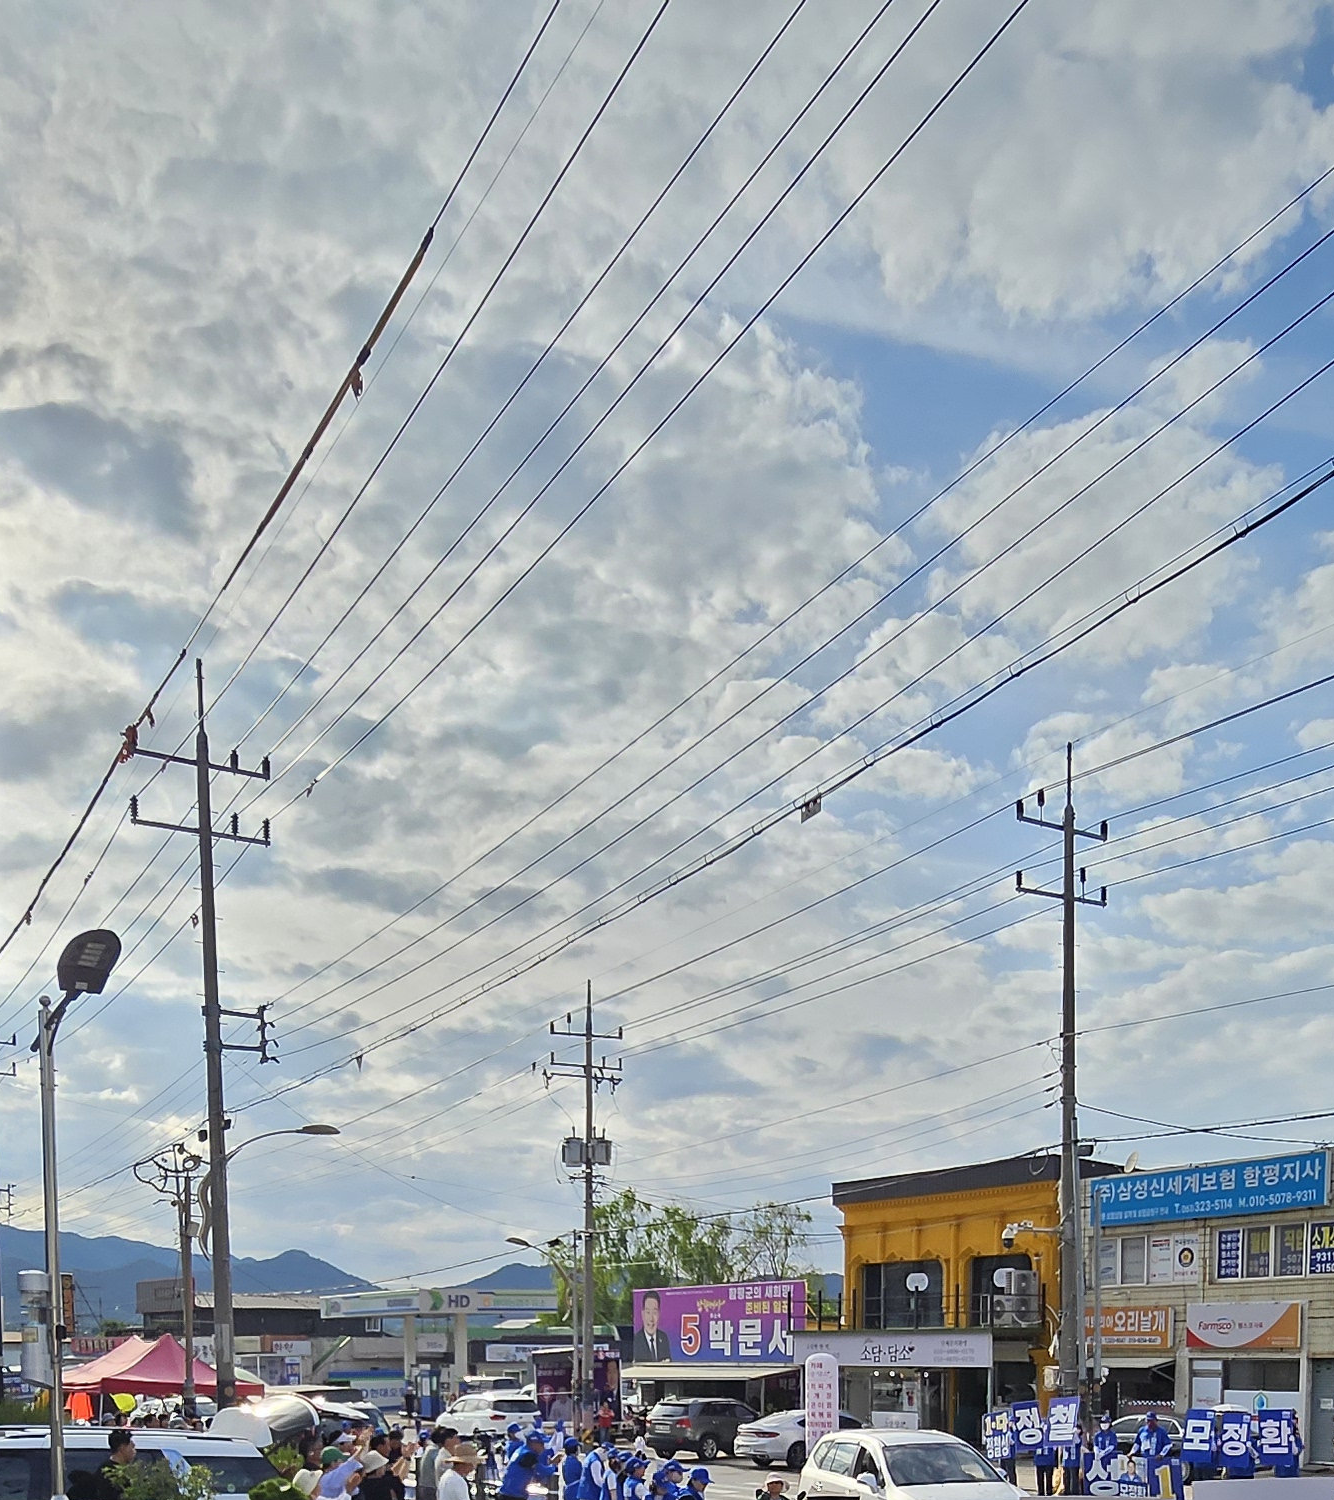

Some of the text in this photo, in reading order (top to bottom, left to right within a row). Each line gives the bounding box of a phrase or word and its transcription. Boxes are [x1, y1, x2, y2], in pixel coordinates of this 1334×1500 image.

[1094, 1157, 1322, 1204] (주)삼성신세계보험 함평지사
[1238, 1189, 1317, 1208] M.010-5078-9311
[448, 1295, 470, 1308] HD
[680, 1314, 702, 1356] 5
[1114, 1310, 1166, 1332] 오리날개
[1198, 1319, 1232, 1332] Farmsco
[1016, 1408, 1043, 1445] 정
[1049, 1404, 1076, 1442] 철
[1183, 1419, 1212, 1451] 모
[1222, 1422, 1248, 1456] 정
[1260, 1420, 1293, 1454] 환
[1086, 1457, 1118, 1497] 성
